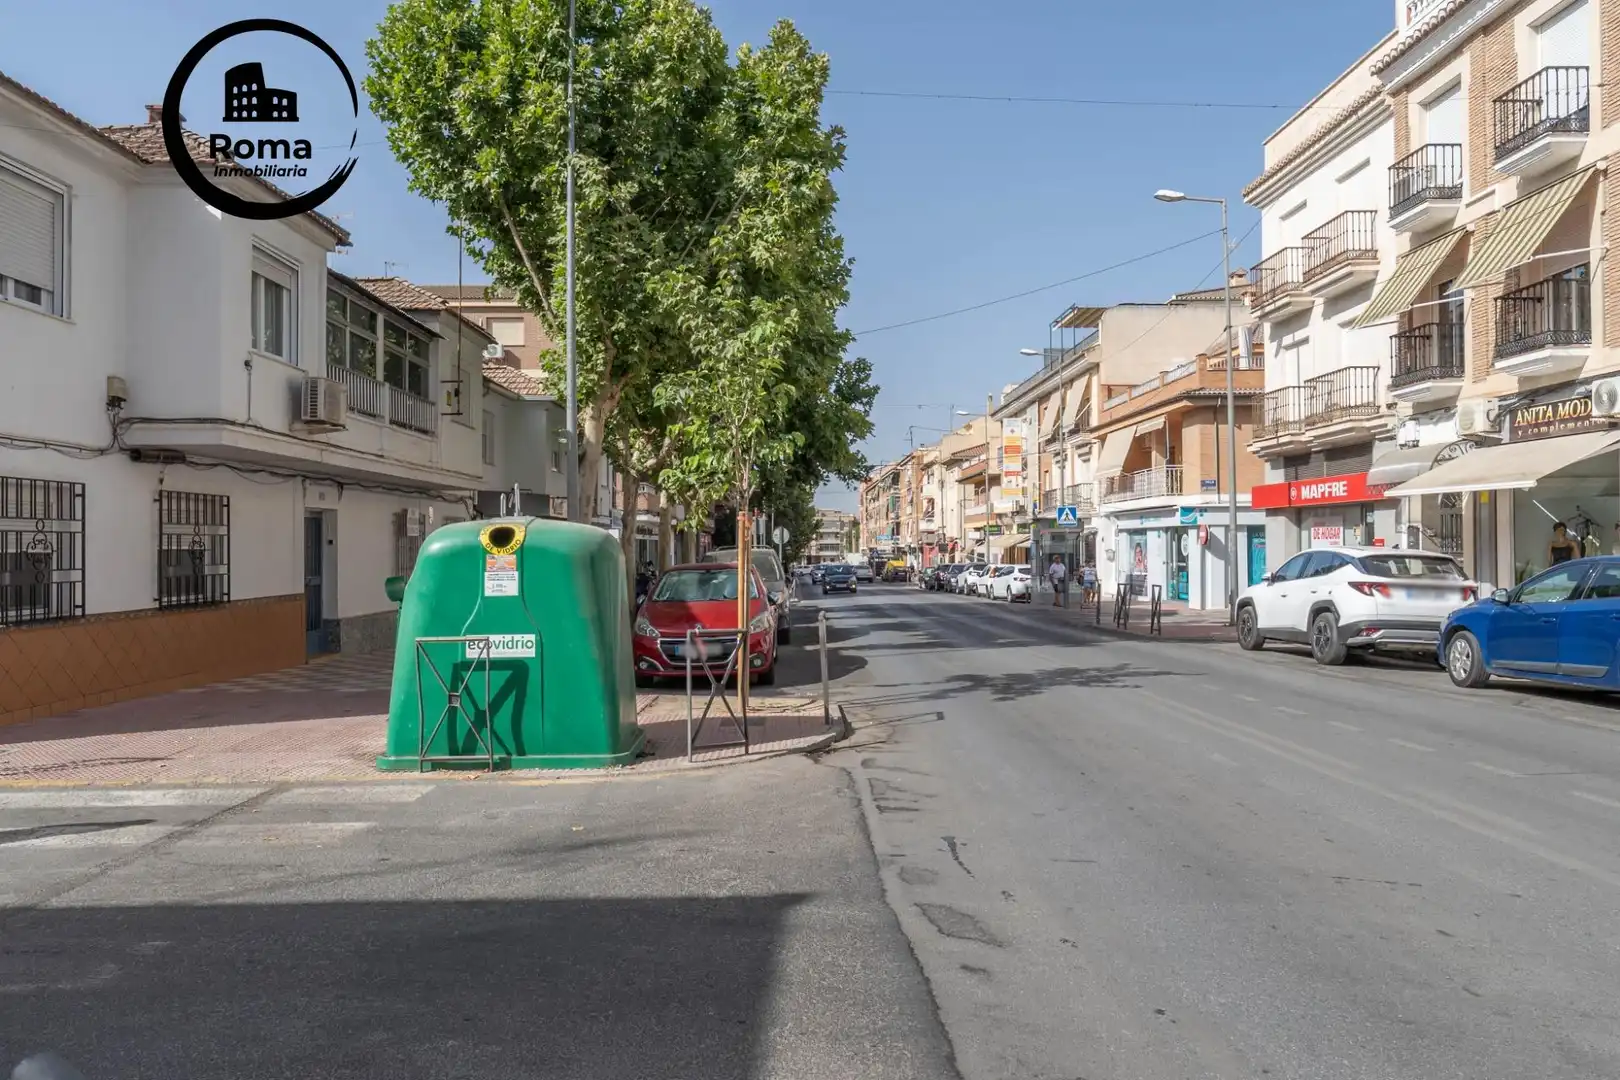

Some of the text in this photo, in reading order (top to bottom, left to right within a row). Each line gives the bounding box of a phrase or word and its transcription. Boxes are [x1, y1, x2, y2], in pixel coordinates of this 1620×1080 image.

[1514, 398, 1592, 426] ANITA MOD
[1517, 429, 1523, 438] y
[1300, 480, 1348, 500] MAPFRE
[1313, 527, 1341, 540] DE HOGAR
[496, 539, 521, 554] VIDRIO
